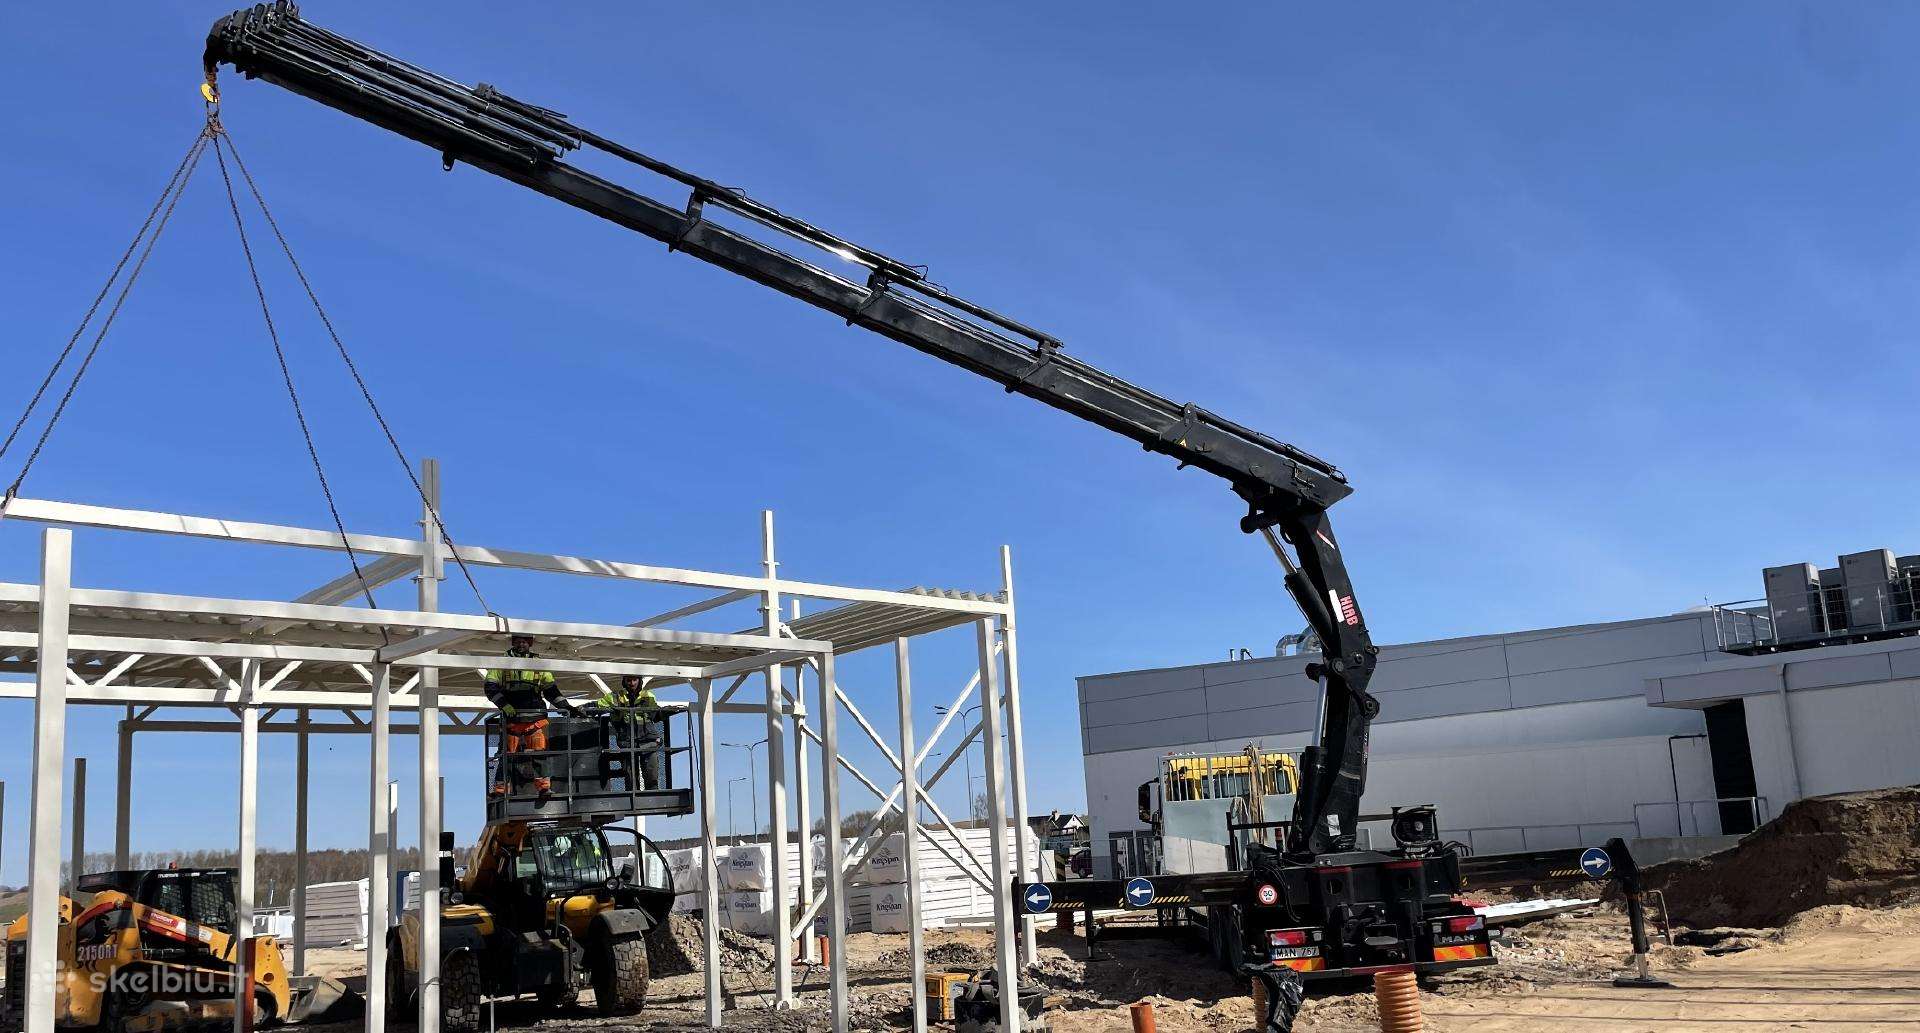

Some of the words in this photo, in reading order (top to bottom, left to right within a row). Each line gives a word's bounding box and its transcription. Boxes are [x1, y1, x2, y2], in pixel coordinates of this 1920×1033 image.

[1340, 595, 1358, 625] HIAB
[876, 902, 902, 912] Kingspan
[1442, 934, 1475, 943] MAN
[77, 944, 118, 961] 2150RT
